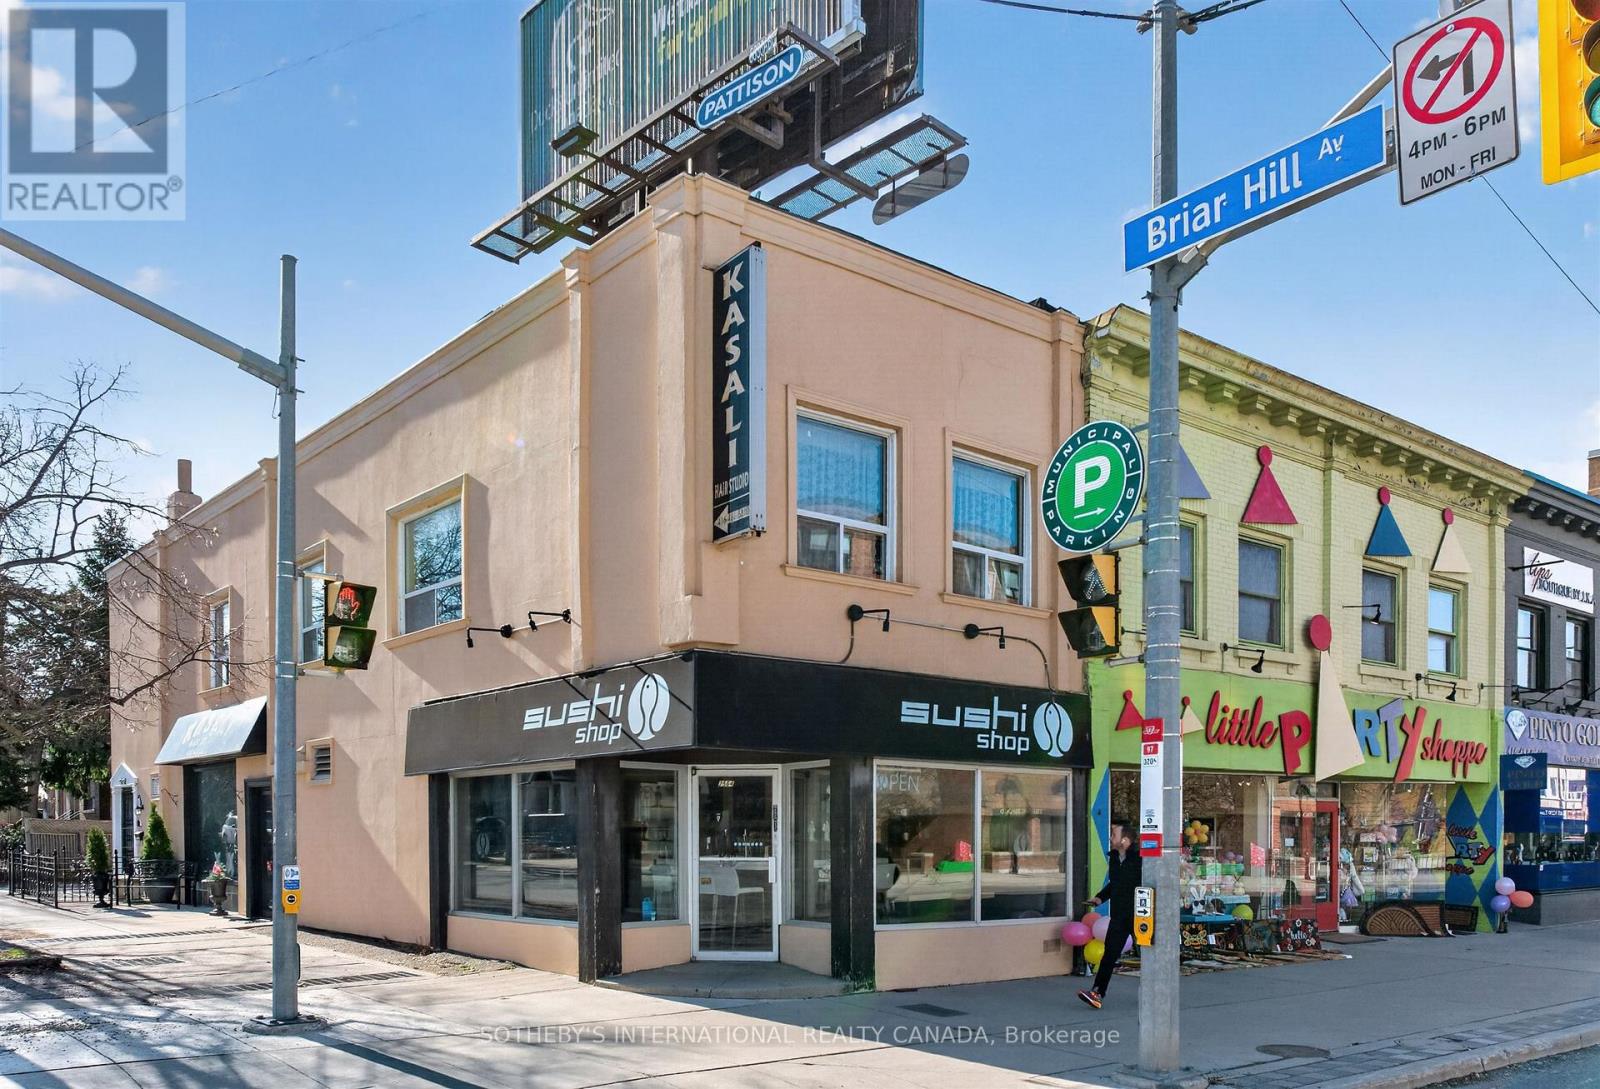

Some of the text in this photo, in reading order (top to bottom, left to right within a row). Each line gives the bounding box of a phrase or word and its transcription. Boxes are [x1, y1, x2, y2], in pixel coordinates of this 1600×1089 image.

[704, 58, 794, 121] PATTISON
[1408, 132, 1447, 159] 4PM
[1464, 106, 1506, 136] 6PM
[1421, 163, 1455, 190] MON
[1470, 146, 1496, 170] FRI
[1147, 192, 1227, 253] Briar
[1244, 151, 1303, 210] Hill
[720, 260, 746, 469] KASALI
[714, 471, 749, 499] HAIR STUDIO
[1046, 427, 1136, 494] MUNICIPAL
[1073, 455, 1111, 509] P
[1046, 487, 1135, 546] PARKING
[522, 683, 626, 731] sushi
[574, 722, 623, 745] shop
[900, 696, 1028, 732] sushi
[1205, 690, 1281, 748] little
[1529, 716, 1573, 743] PINTO
[976, 731, 1030, 755] shop
